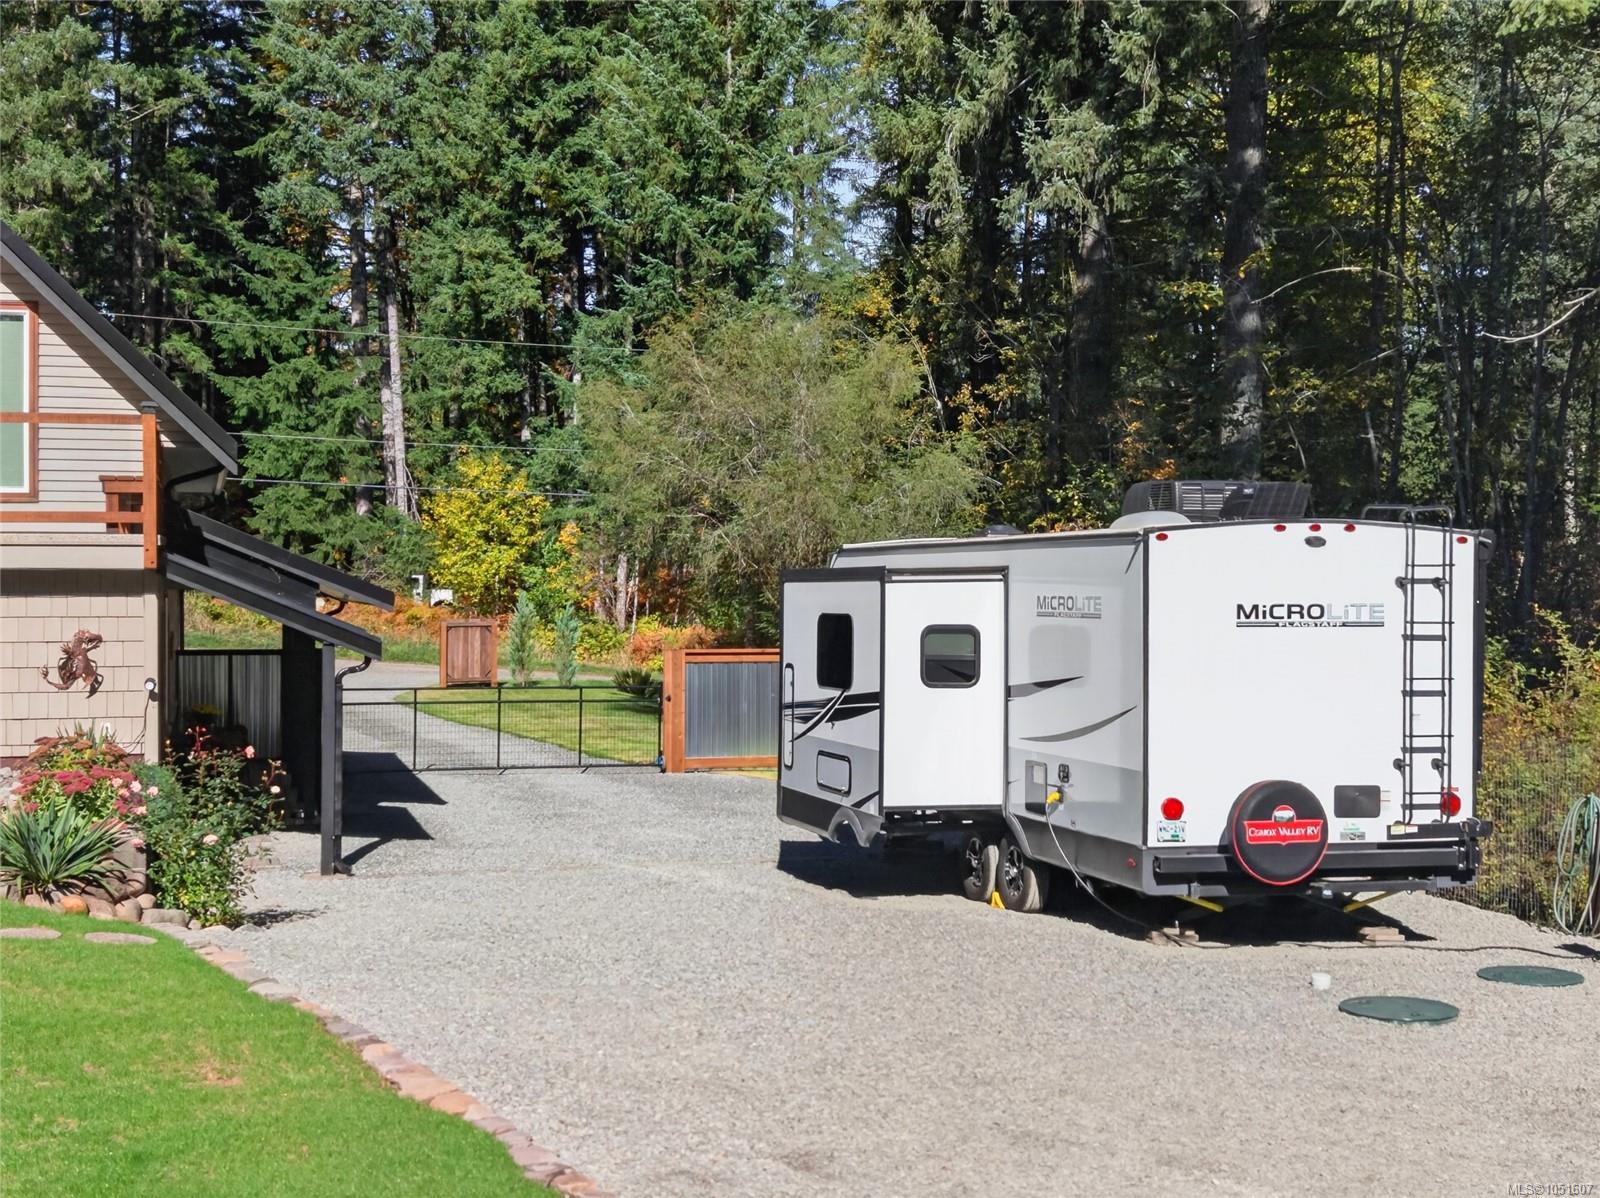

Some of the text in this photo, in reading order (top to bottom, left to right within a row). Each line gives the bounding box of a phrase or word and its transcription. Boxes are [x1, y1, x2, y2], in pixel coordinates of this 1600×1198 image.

[1236, 603, 1385, 620] MiCROLiTE
[1278, 826, 1306, 837] VALLEY
[1306, 825, 1320, 837] RV
